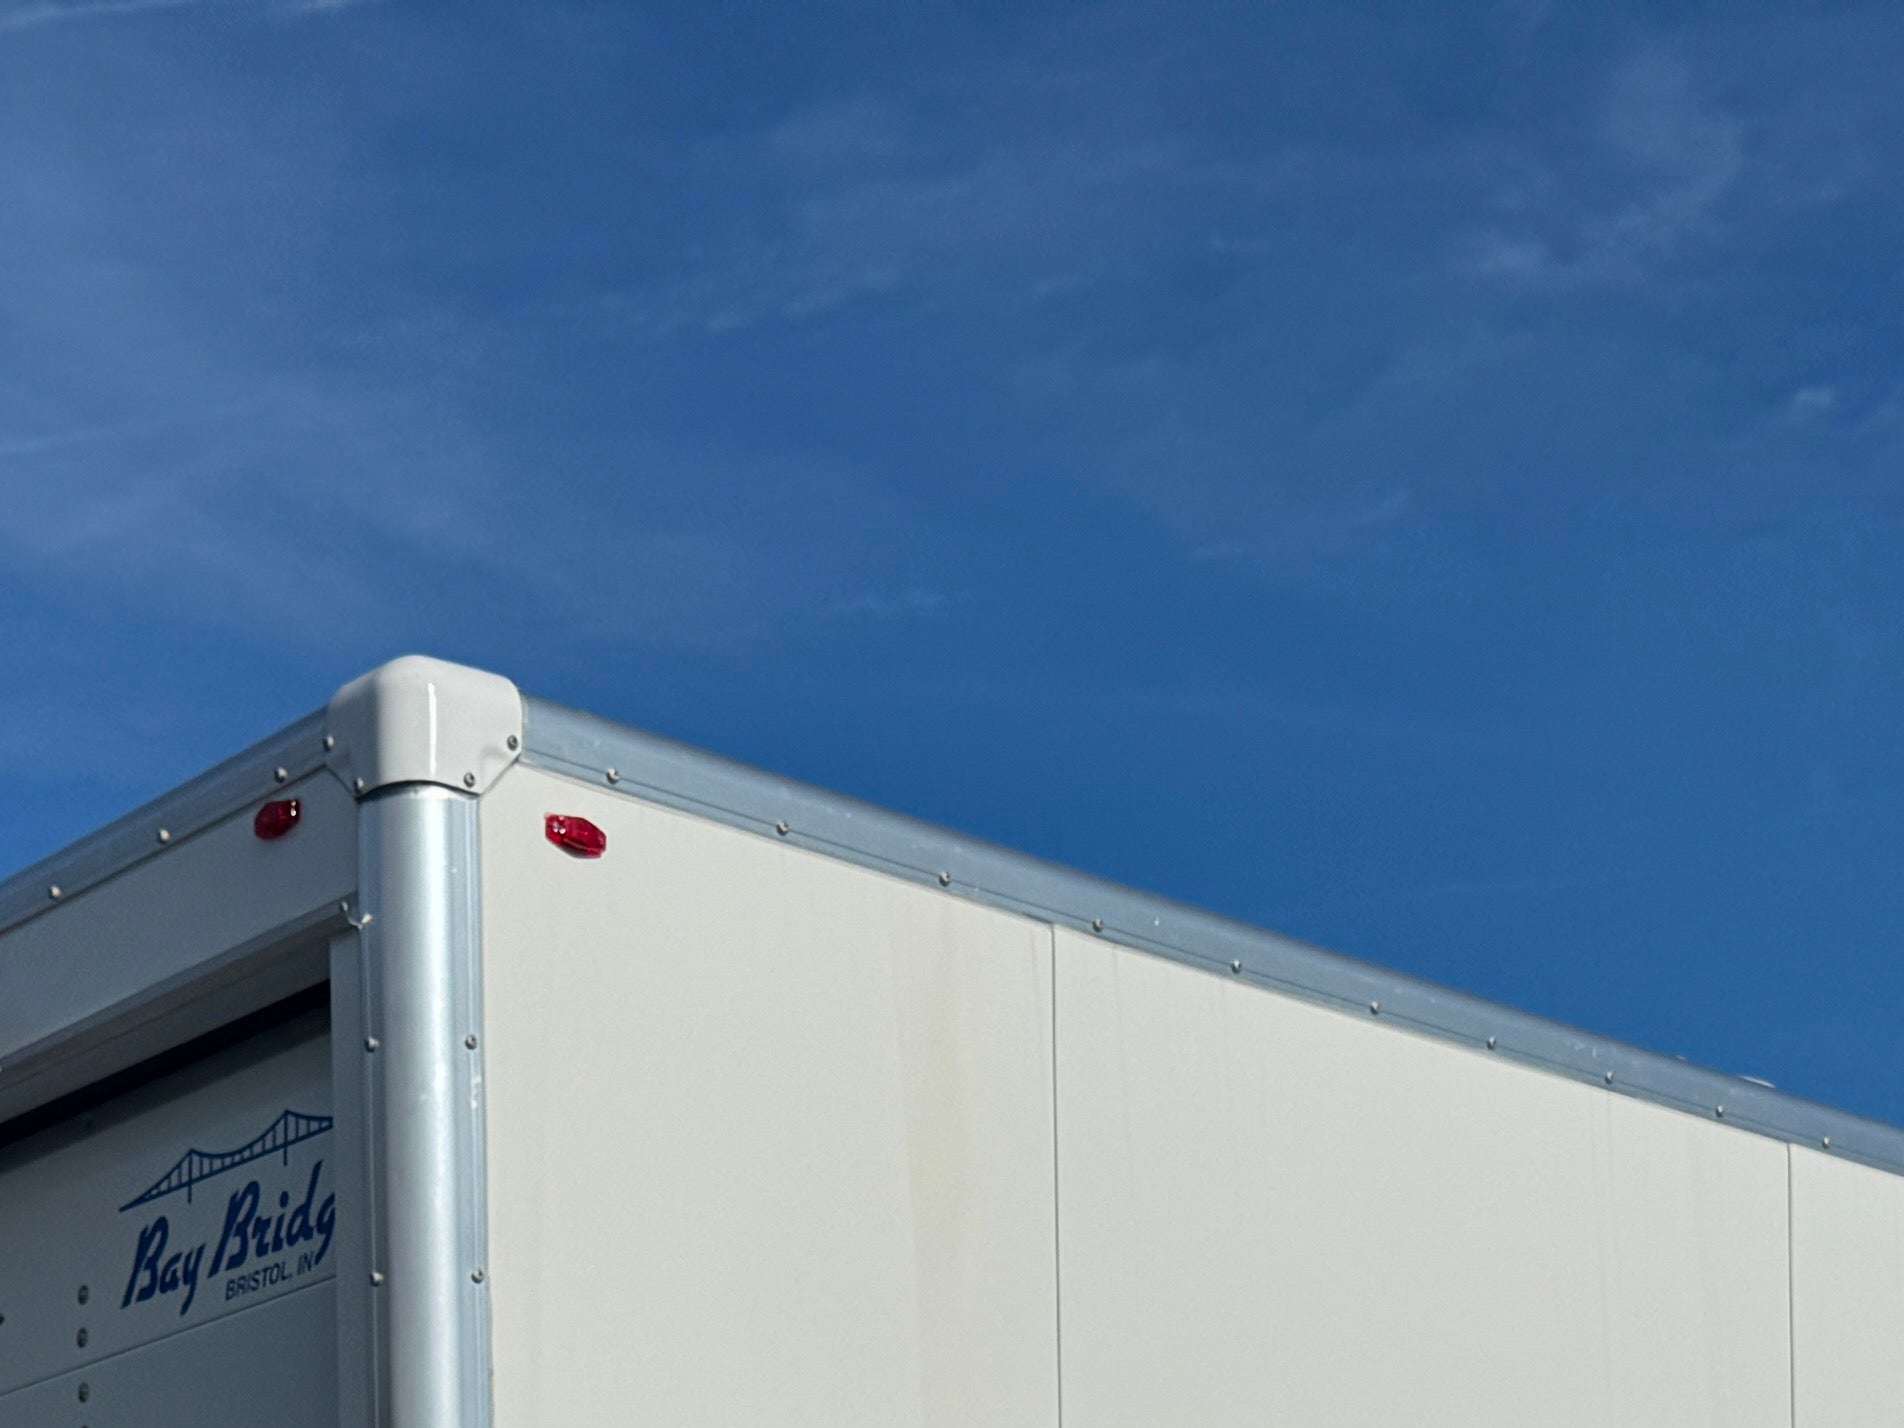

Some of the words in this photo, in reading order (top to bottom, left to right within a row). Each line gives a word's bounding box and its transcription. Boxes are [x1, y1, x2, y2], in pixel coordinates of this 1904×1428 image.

[120, 1215, 207, 1317] Bay
[207, 1159, 336, 1279] Bridg
[297, 1250, 315, 1275] IN
